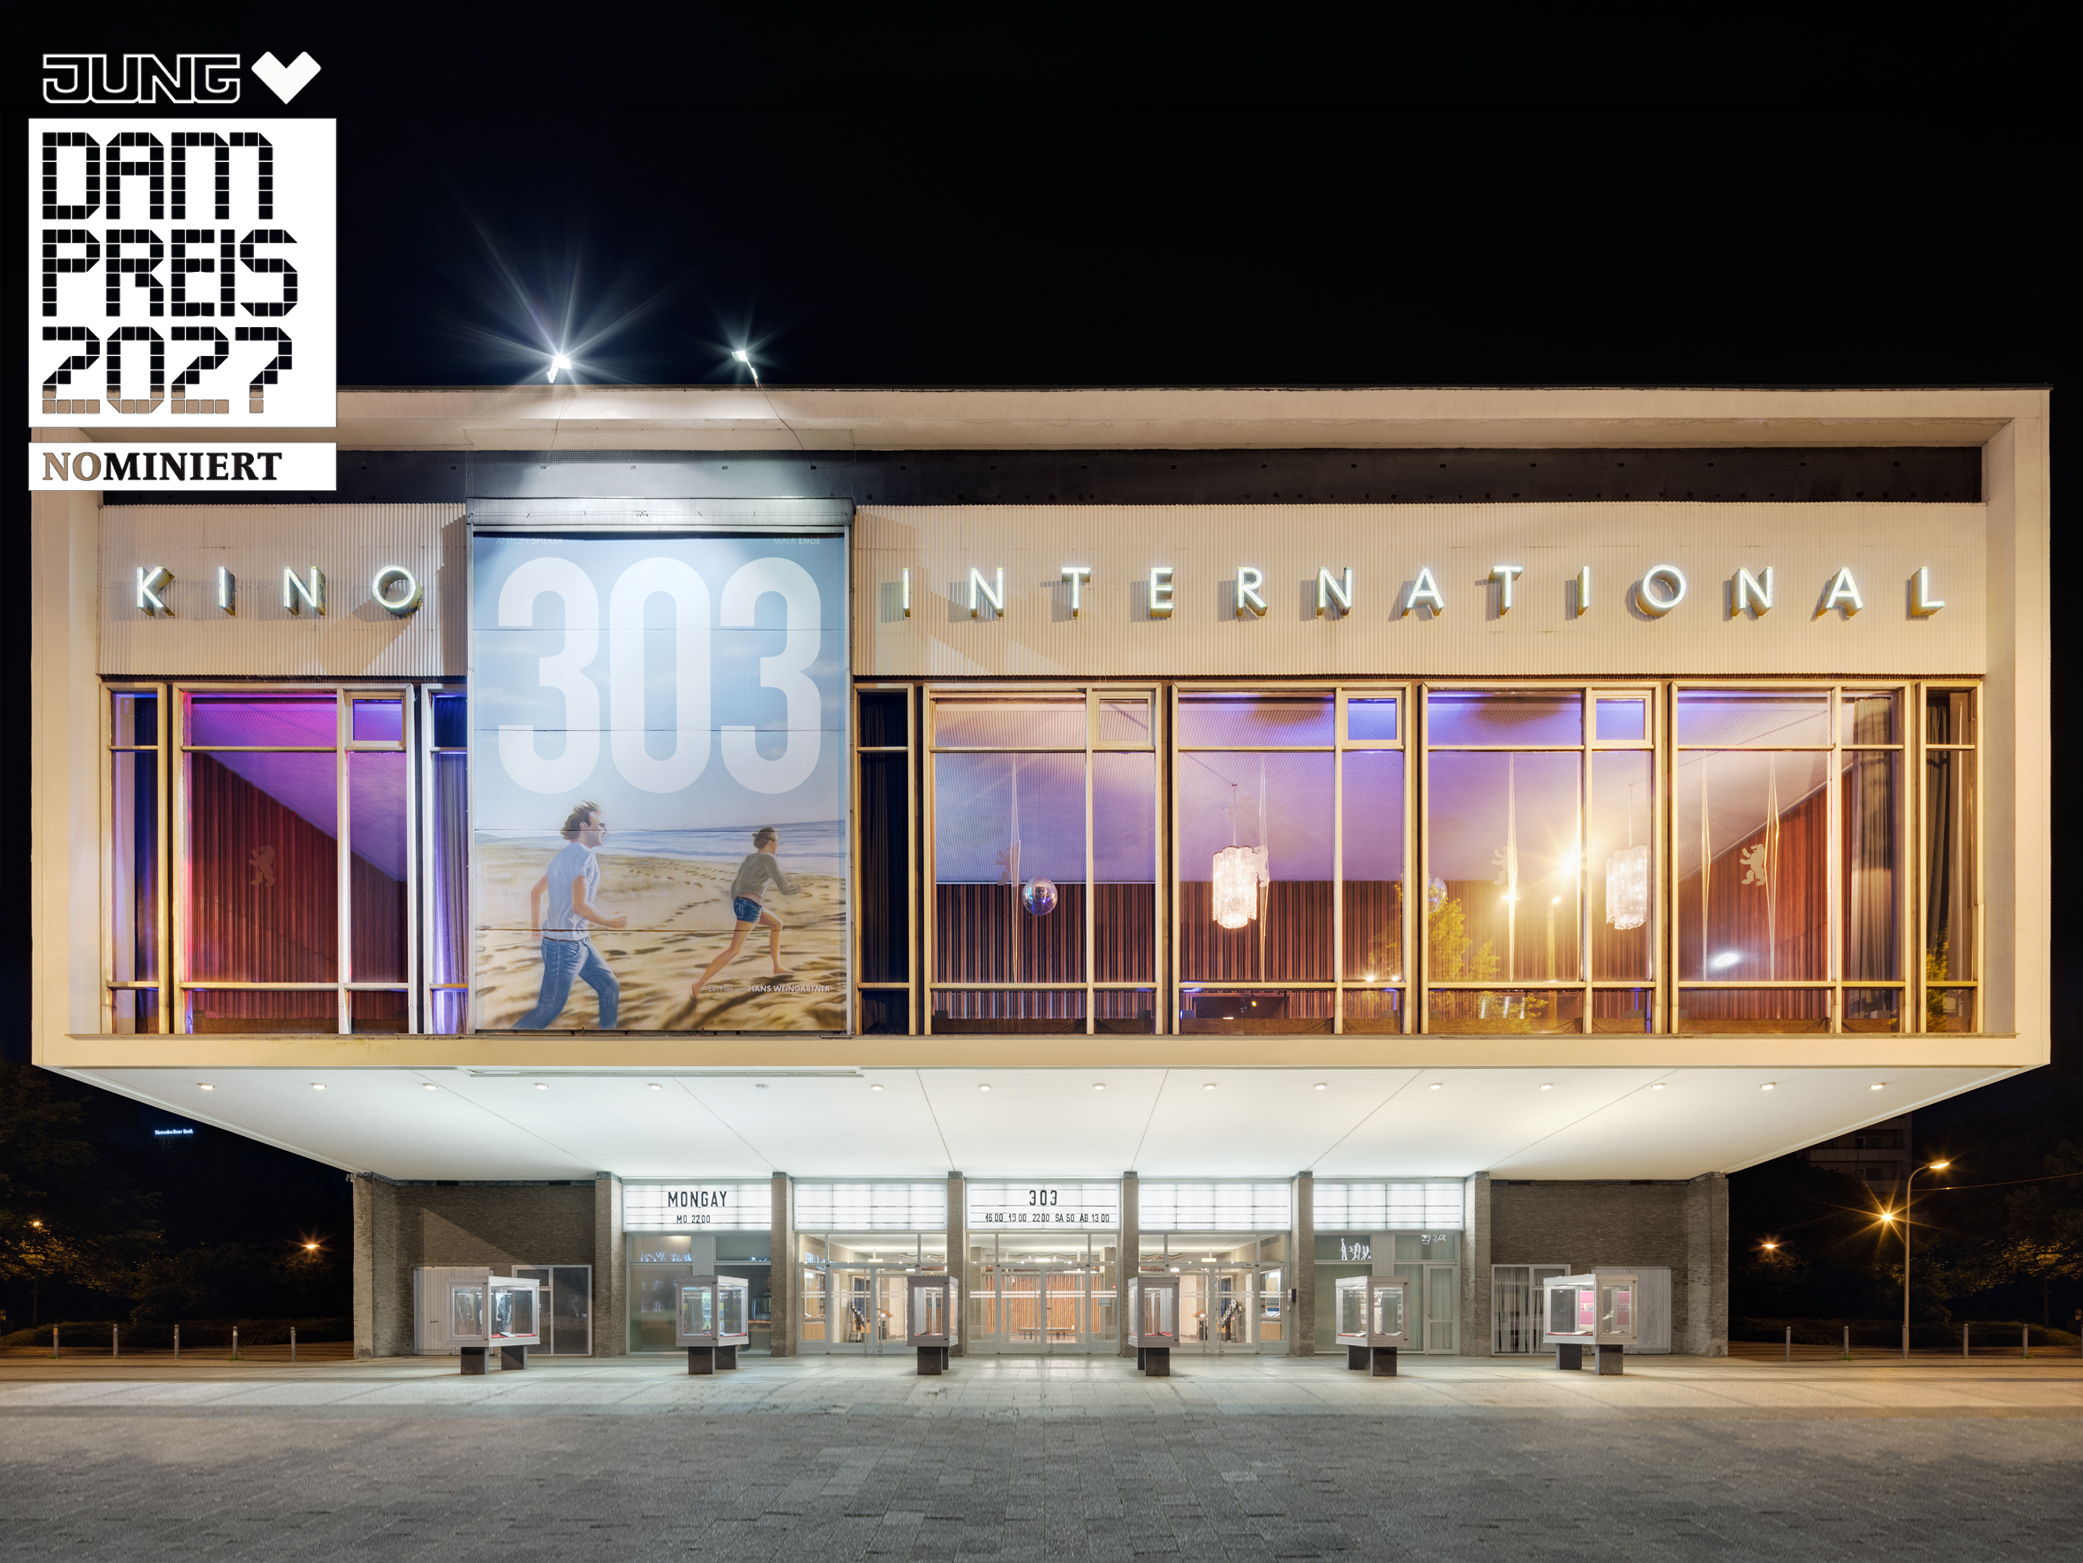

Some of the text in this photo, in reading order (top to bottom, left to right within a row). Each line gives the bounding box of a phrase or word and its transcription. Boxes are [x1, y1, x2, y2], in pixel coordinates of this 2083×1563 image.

[799, 537, 821, 545] EMDE
[136, 564, 1946, 620] KINO INTERNATIONAL
[498, 557, 821, 794] 303
[748, 985, 772, 993] HANS
[773, 985, 831, 993] WEINGARTNER
[668, 1191, 727, 1207] MONGAY
[1029, 1190, 1058, 1206] 303
[676, 1215, 688, 1224] MO
[1079, 1213, 1089, 1223] AB
